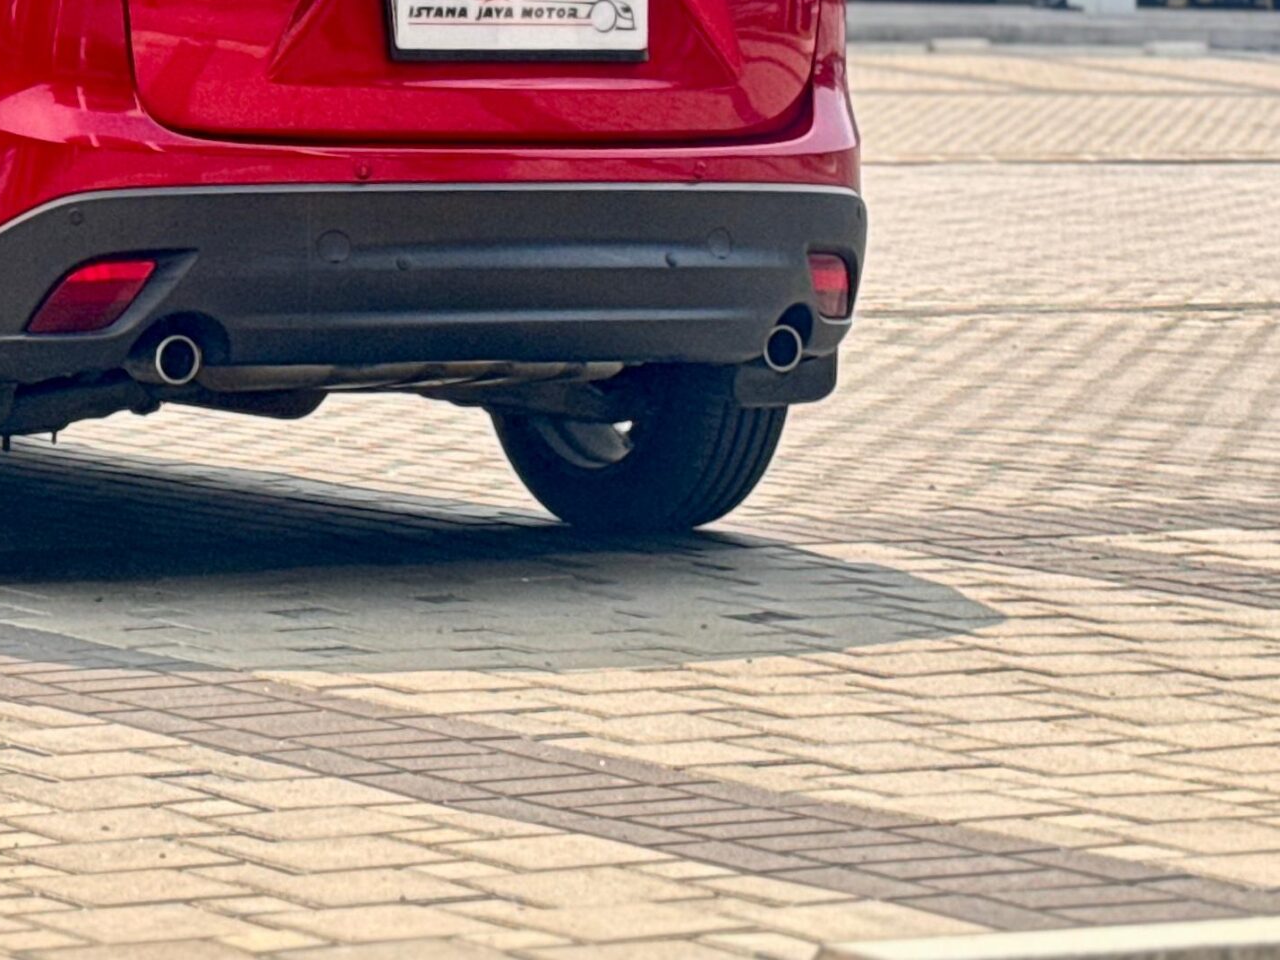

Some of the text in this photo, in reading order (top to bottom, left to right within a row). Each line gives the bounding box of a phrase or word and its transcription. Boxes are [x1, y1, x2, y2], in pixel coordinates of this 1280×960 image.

[408, 6, 579, 21] ISTANA JAYA MOTOR
